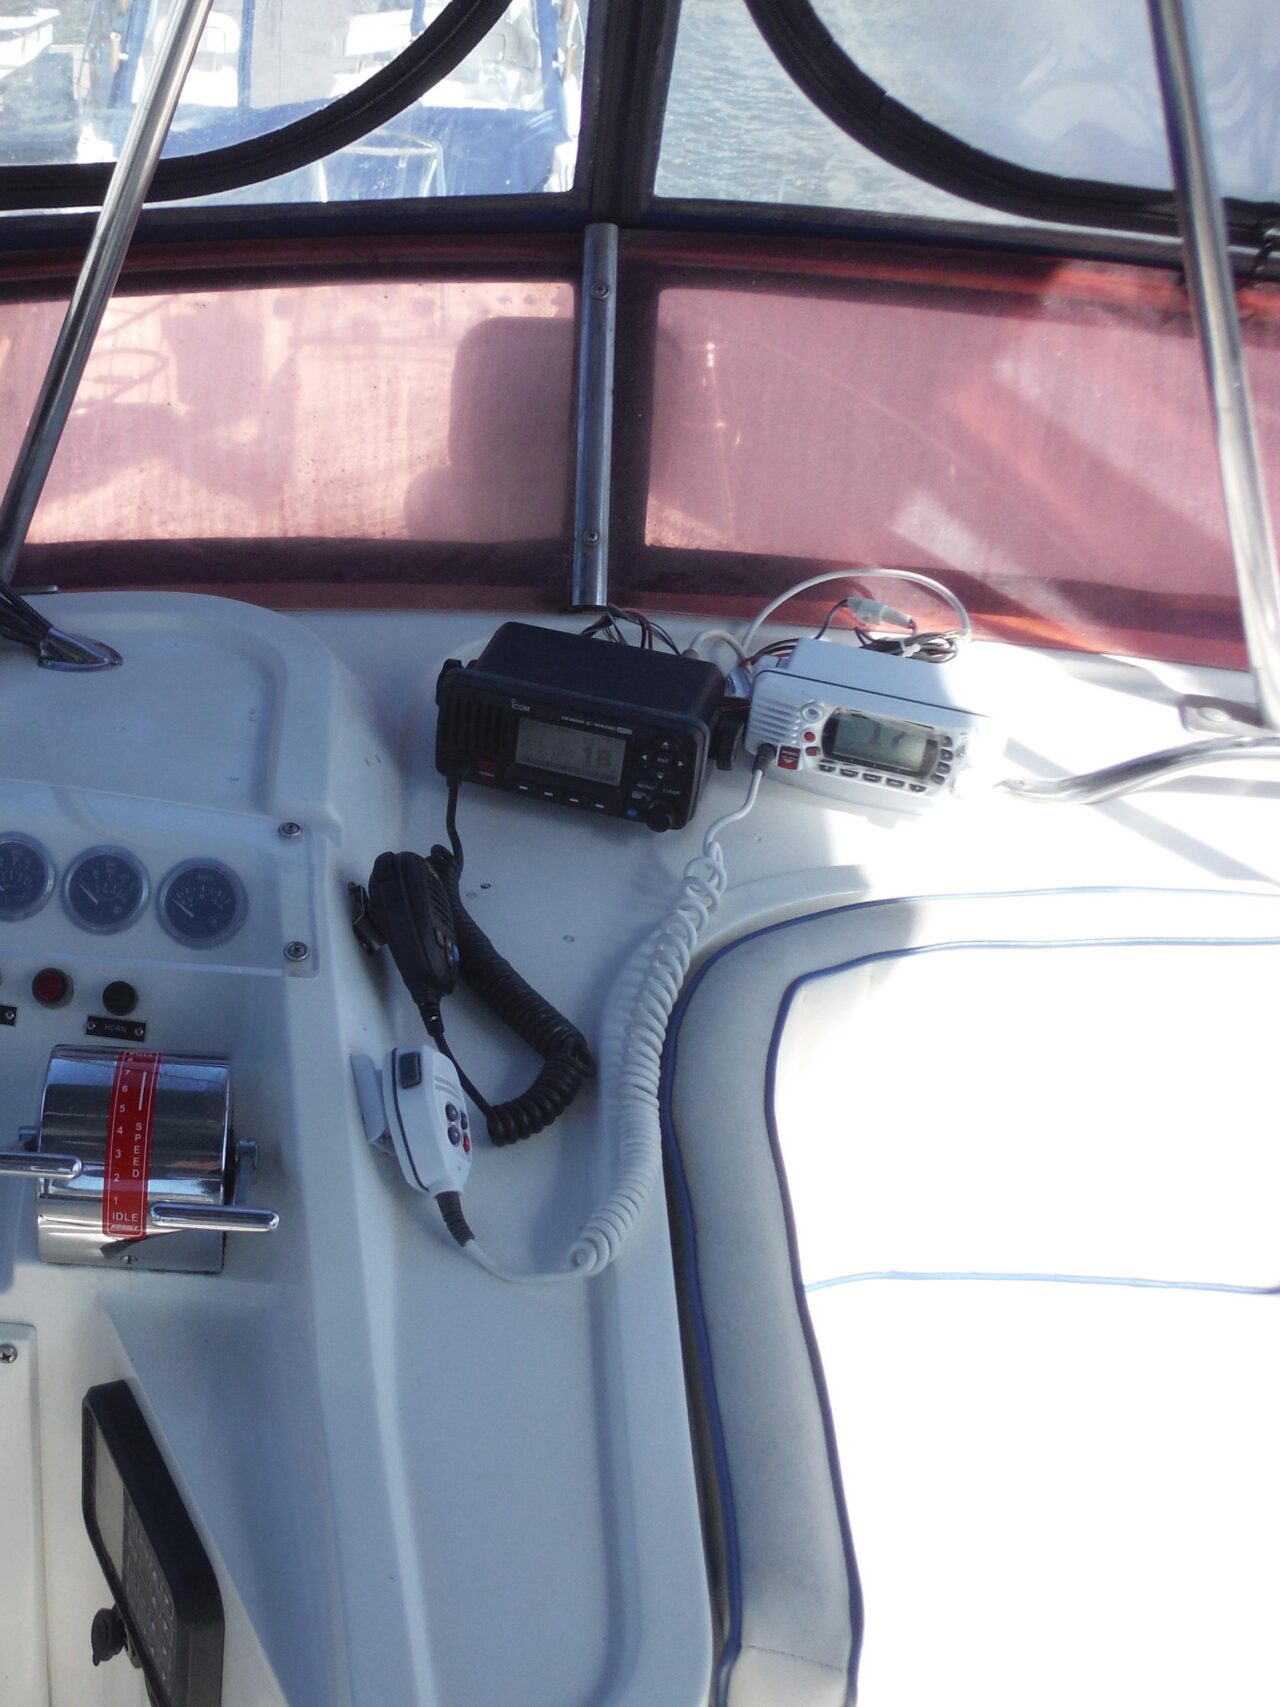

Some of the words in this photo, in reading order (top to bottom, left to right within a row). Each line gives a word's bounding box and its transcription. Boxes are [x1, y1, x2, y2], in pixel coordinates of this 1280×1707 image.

[511, 698, 531, 712] ICOM
[104, 1023, 128, 1033] HORN
[122, 1085, 129, 1093] 6
[120, 1104, 126, 1113] 5
[117, 1126, 124, 1134] 4
[115, 1149, 122, 1159] 3
[132, 1122, 143, 1178] SPEED
[113, 1173, 120, 1182] 2
[113, 1196, 118, 1205] 1
[112, 1212, 139, 1222] IDLE
